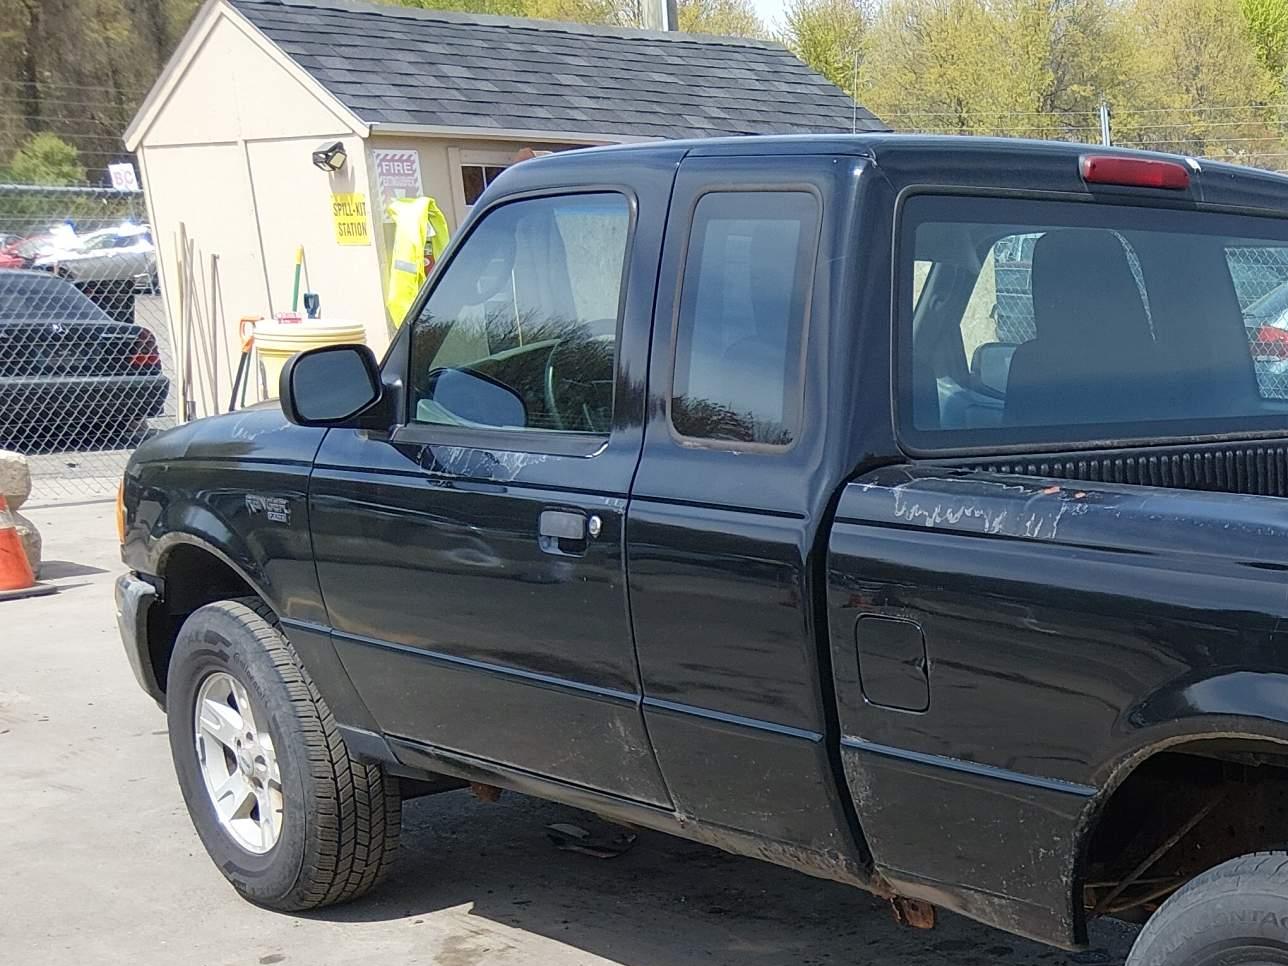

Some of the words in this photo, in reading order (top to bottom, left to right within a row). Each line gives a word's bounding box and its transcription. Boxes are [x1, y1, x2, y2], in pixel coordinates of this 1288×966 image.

[382, 161, 413, 174] FIRE
[112, 170, 134, 186] BC
[333, 201, 367, 217] SPILL-KIT
[338, 222, 367, 237] STATION
